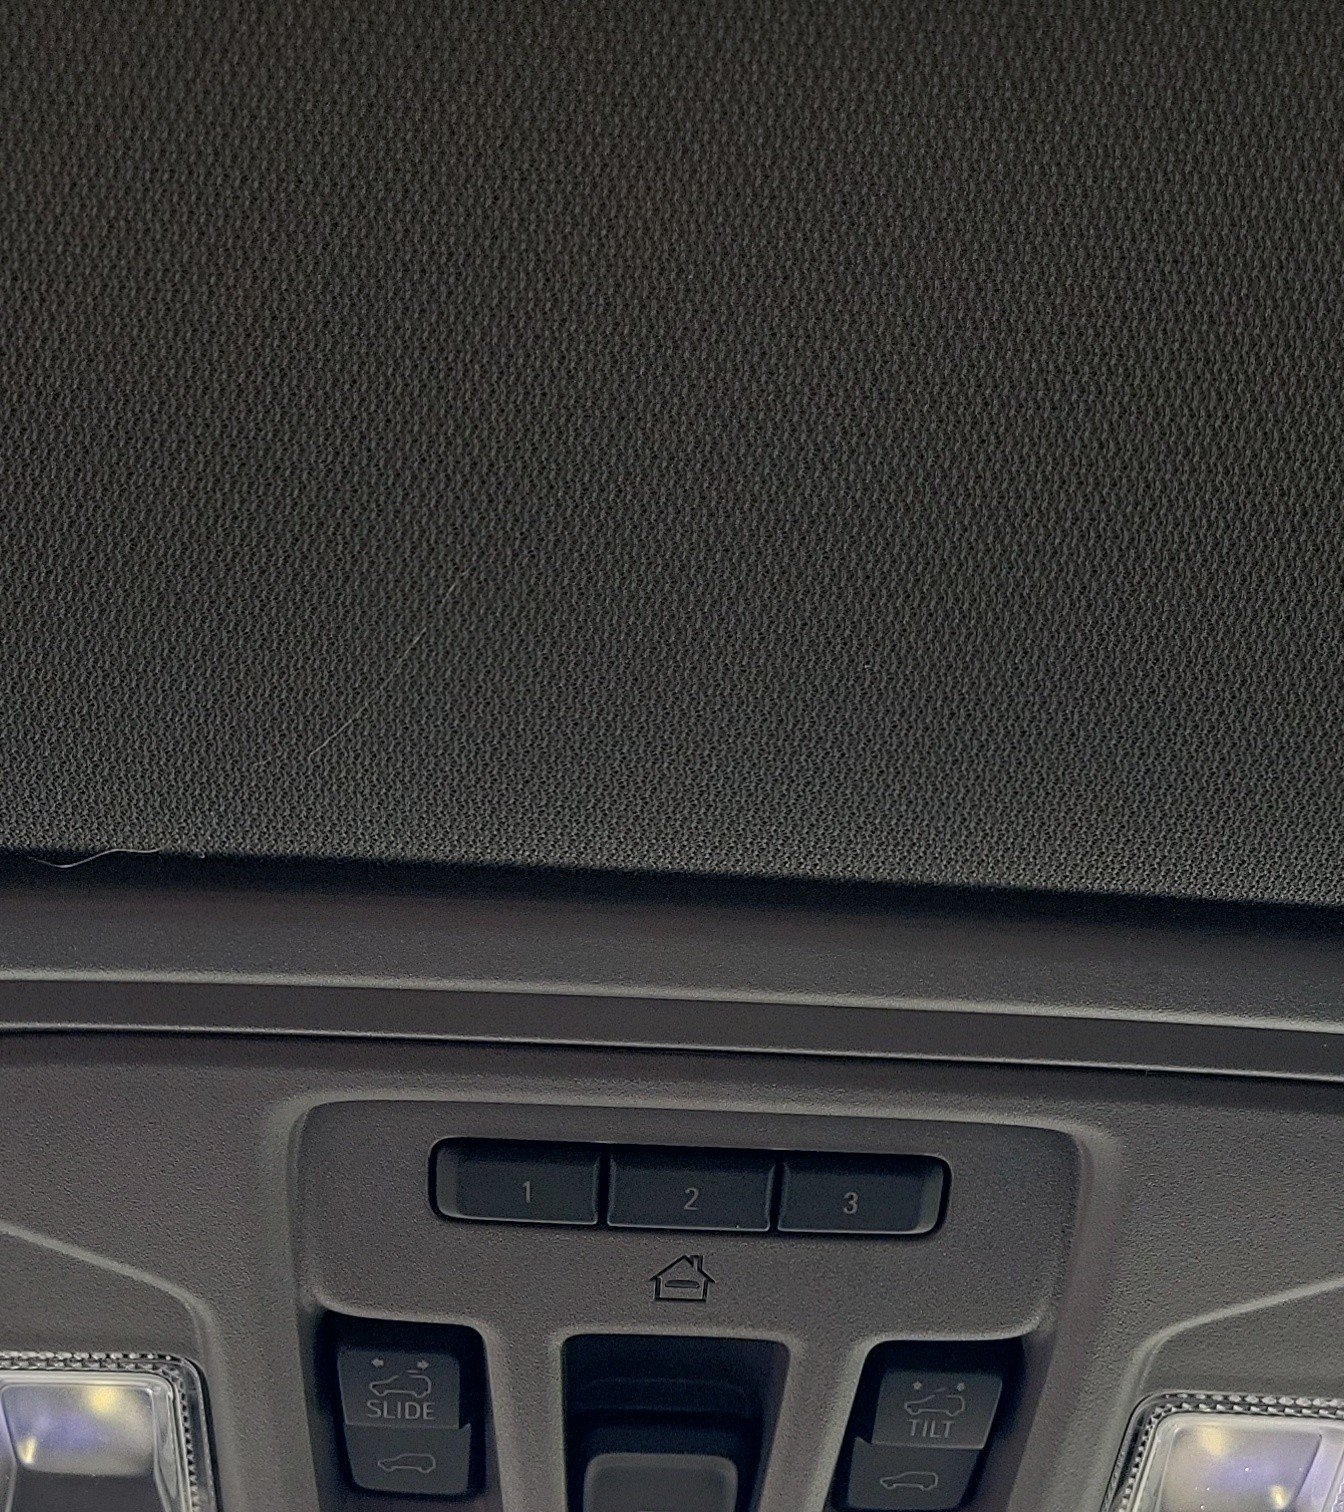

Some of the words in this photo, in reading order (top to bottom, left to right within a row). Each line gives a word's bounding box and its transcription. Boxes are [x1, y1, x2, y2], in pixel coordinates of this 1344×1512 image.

[522, 1181, 534, 1203] 1
[683, 1187, 700, 1211] 2
[842, 1191, 859, 1214] 3
[366, 1400, 436, 1420] SLIDE
[906, 1419, 956, 1438] TILT
